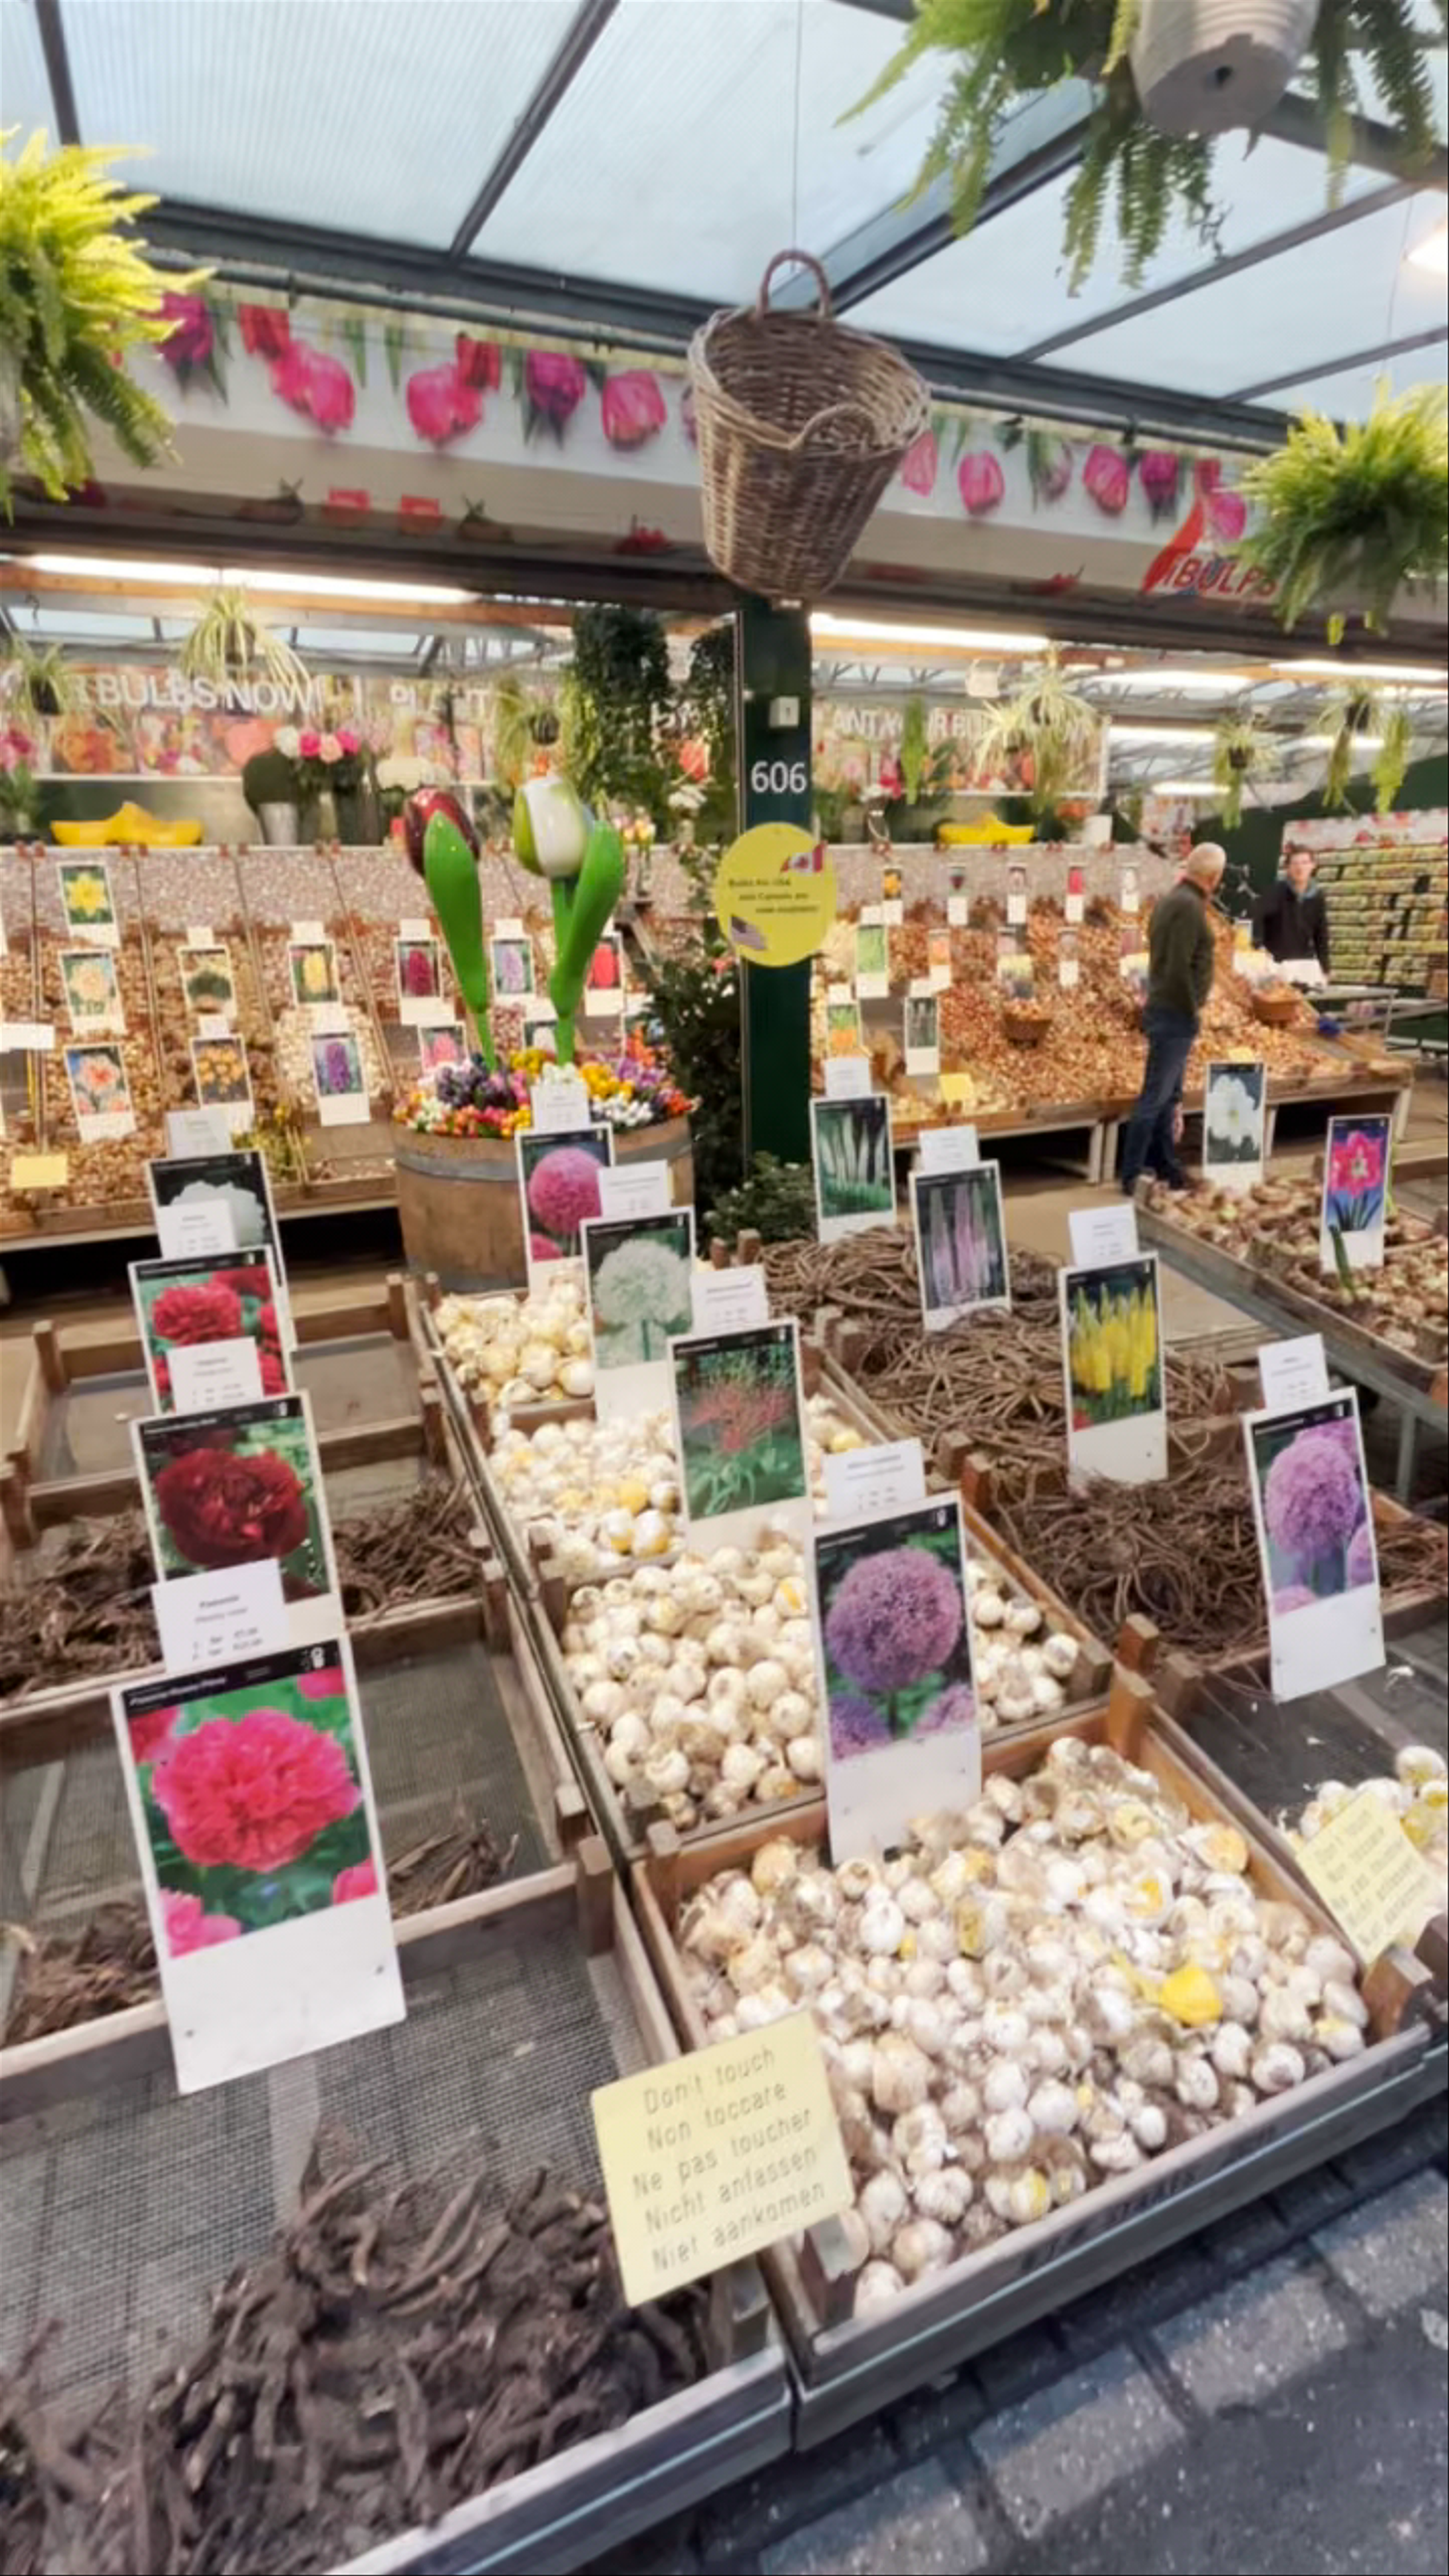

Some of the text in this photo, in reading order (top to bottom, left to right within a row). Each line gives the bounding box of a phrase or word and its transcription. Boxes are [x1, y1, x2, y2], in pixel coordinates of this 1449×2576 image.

[96, 674, 218, 709] BULBS
[751, 760, 807, 793] 606
[644, 2045, 775, 2115] Don't touch
[632, 2108, 810, 2198] Ne pas toucher
[647, 2084, 786, 2152] Non toccare
[645, 2147, 817, 2233] Nicht anfassen
[652, 2182, 824, 2271] Niet aankomen
